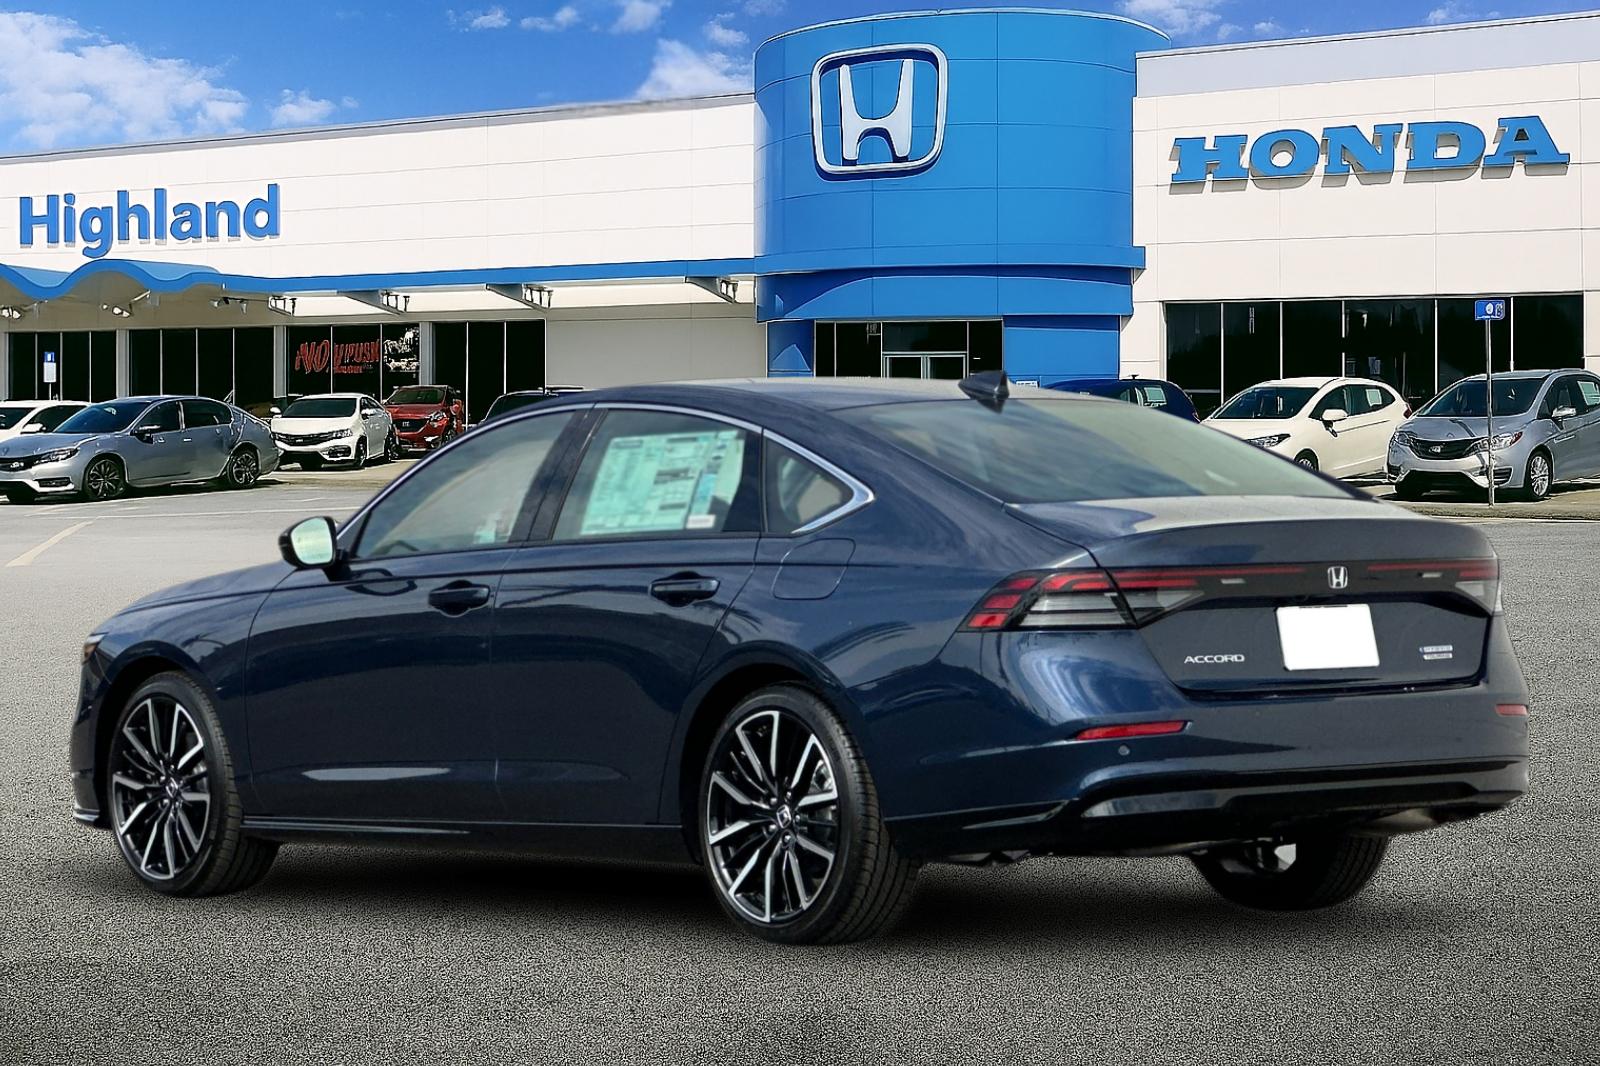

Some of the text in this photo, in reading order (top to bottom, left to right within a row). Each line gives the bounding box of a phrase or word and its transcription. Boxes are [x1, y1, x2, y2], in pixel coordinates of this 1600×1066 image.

[1171, 115, 1570, 184] HONDA
[19, 183, 280, 258] Highland
[1183, 654, 1246, 664] ACCORD
